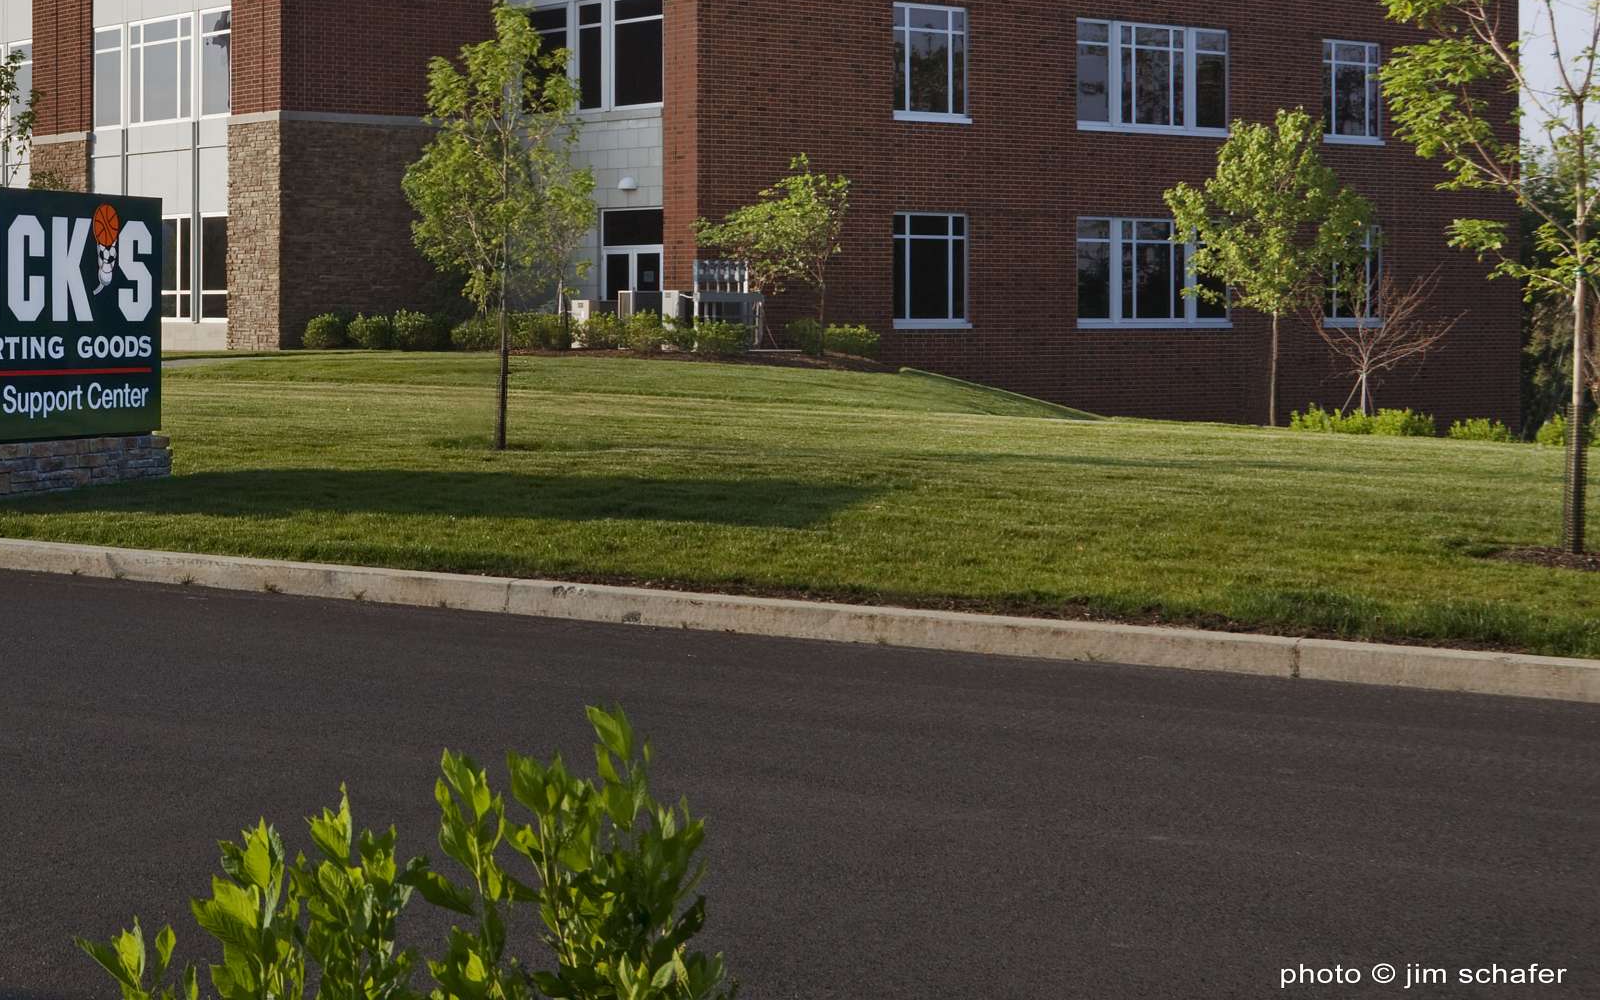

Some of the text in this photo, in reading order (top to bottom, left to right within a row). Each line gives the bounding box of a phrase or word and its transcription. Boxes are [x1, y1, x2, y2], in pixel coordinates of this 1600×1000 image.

[77, 335, 152, 359] GOODS
[2, 384, 83, 419] Support
[87, 382, 149, 409] Center
